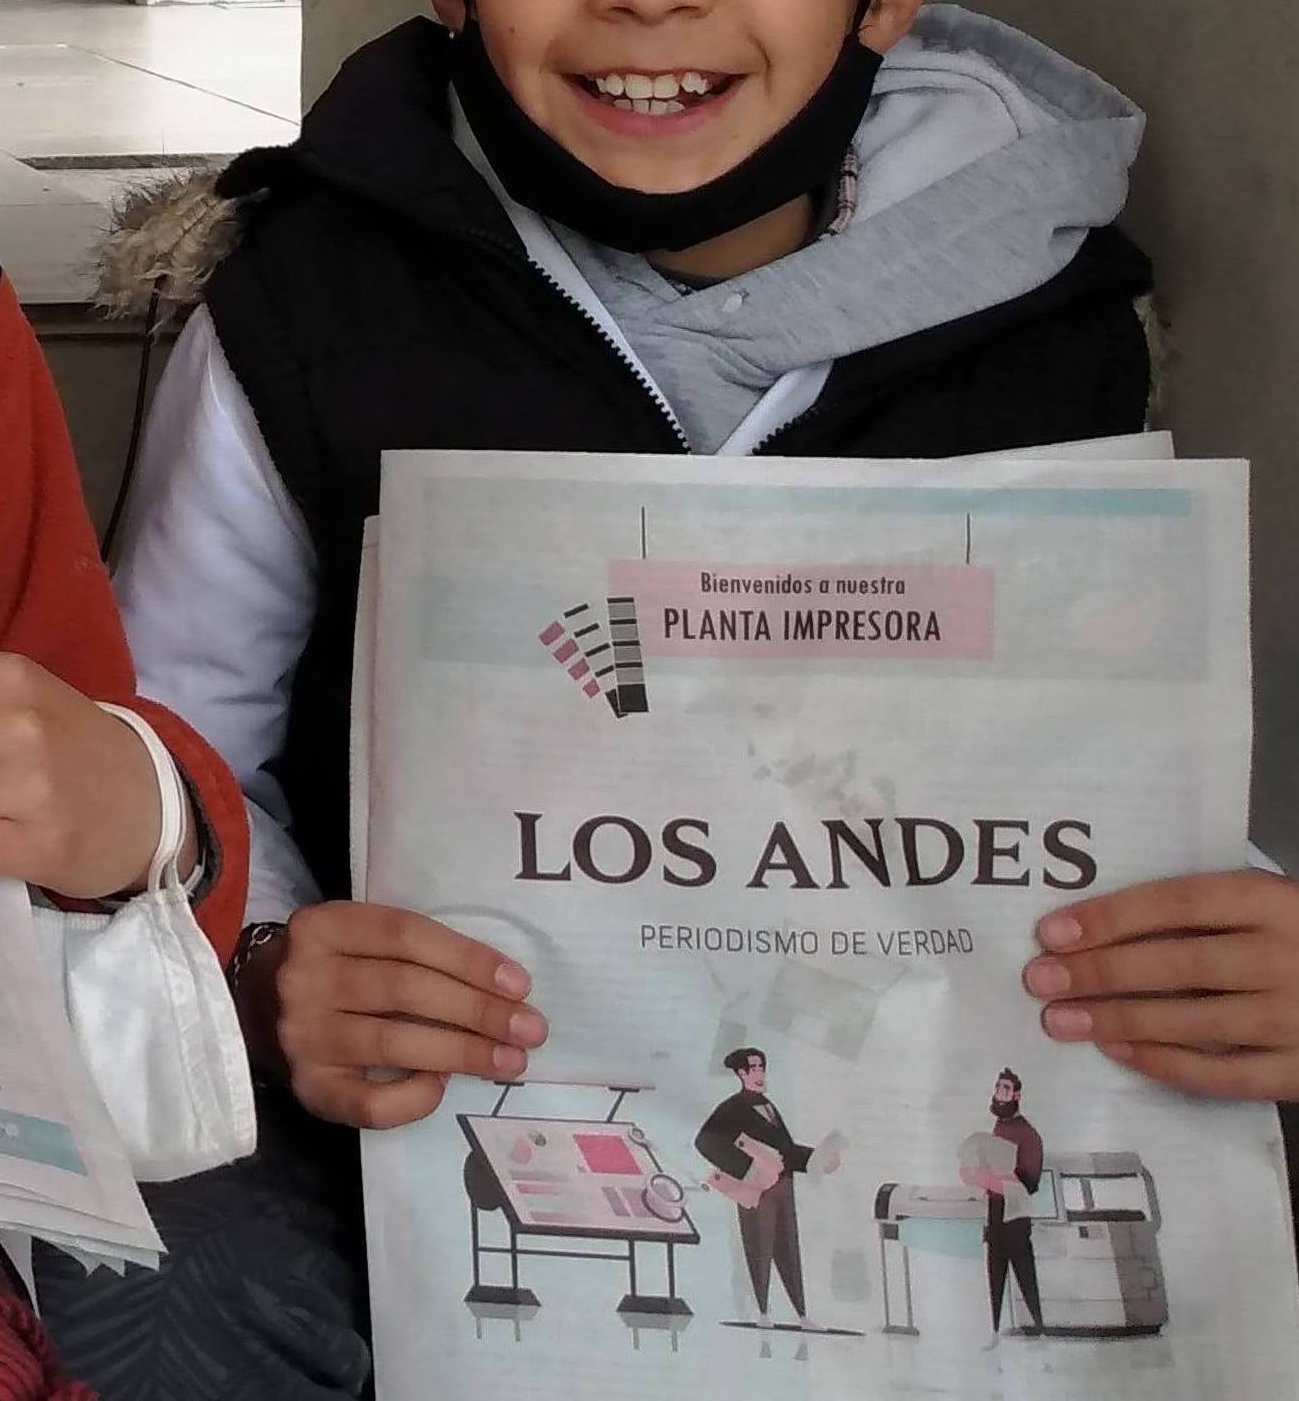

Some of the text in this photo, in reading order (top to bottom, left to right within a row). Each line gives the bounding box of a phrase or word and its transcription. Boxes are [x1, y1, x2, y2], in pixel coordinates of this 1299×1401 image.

[700, 571, 906, 595] Bienvenidos a nuestra
[663, 608, 942, 642] PLANTA IMPRESORA
[513, 810, 1099, 890] LOS ANDES
[640, 924, 975, 956] PERIODISMO DE VERDAD
